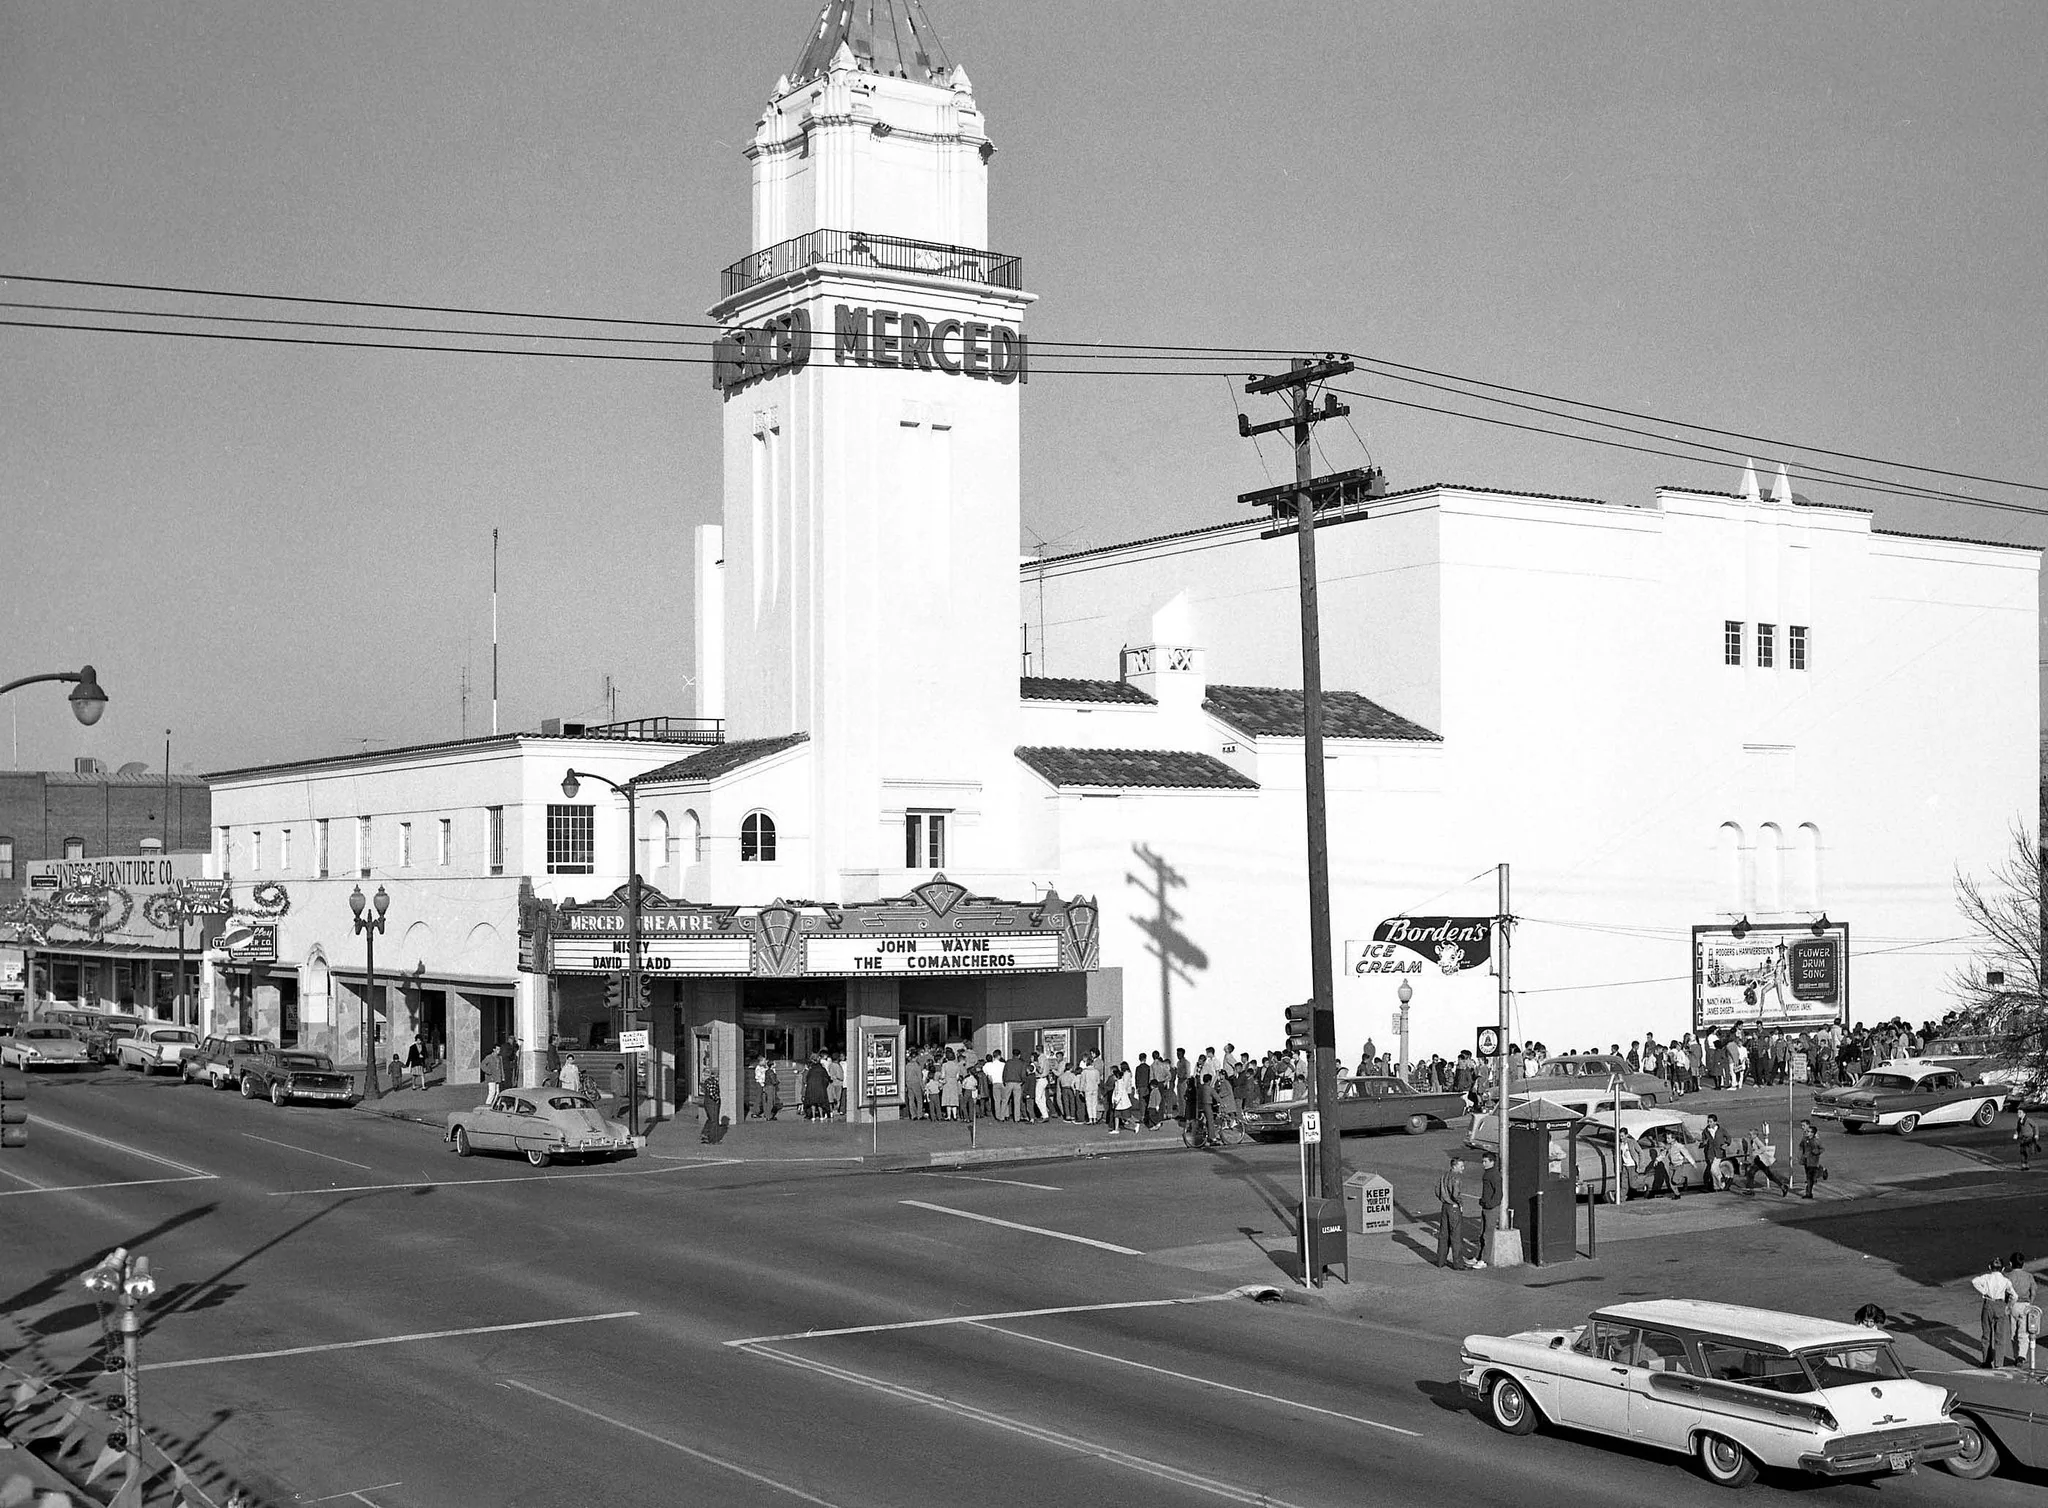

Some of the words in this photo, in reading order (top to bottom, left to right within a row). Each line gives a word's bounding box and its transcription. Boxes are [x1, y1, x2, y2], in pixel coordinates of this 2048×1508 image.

[835, 304, 1019, 383] MERCED
[95, 860, 155, 886] FURNITURE
[159, 860, 175, 886] CO.
[571, 915, 625, 930] MERCED
[1384, 919, 1488, 943] Borden's
[877, 940, 917, 953] JOHN
[941, 939, 990, 953] WAYNE
[1362, 944, 1397, 958] ICE
[1798, 948, 1830, 958] FLOWER
[593, 957, 622, 970] DAVID
[638, 957, 671, 970] LADD
[854, 956, 882, 970] THE
[907, 955, 1015, 969] COMANCHEROS
[1355, 960, 1423, 974] CREAM
[1802, 959, 1825, 968] DRUM
[1803, 970, 1825, 979] SONG
[1307, 1120, 1316, 1130] U
[1366, 1188, 1390, 1198] KEEP
[1378, 1197, 1390, 1205] CITY
[1366, 1204, 1390, 1213] CLEAN
